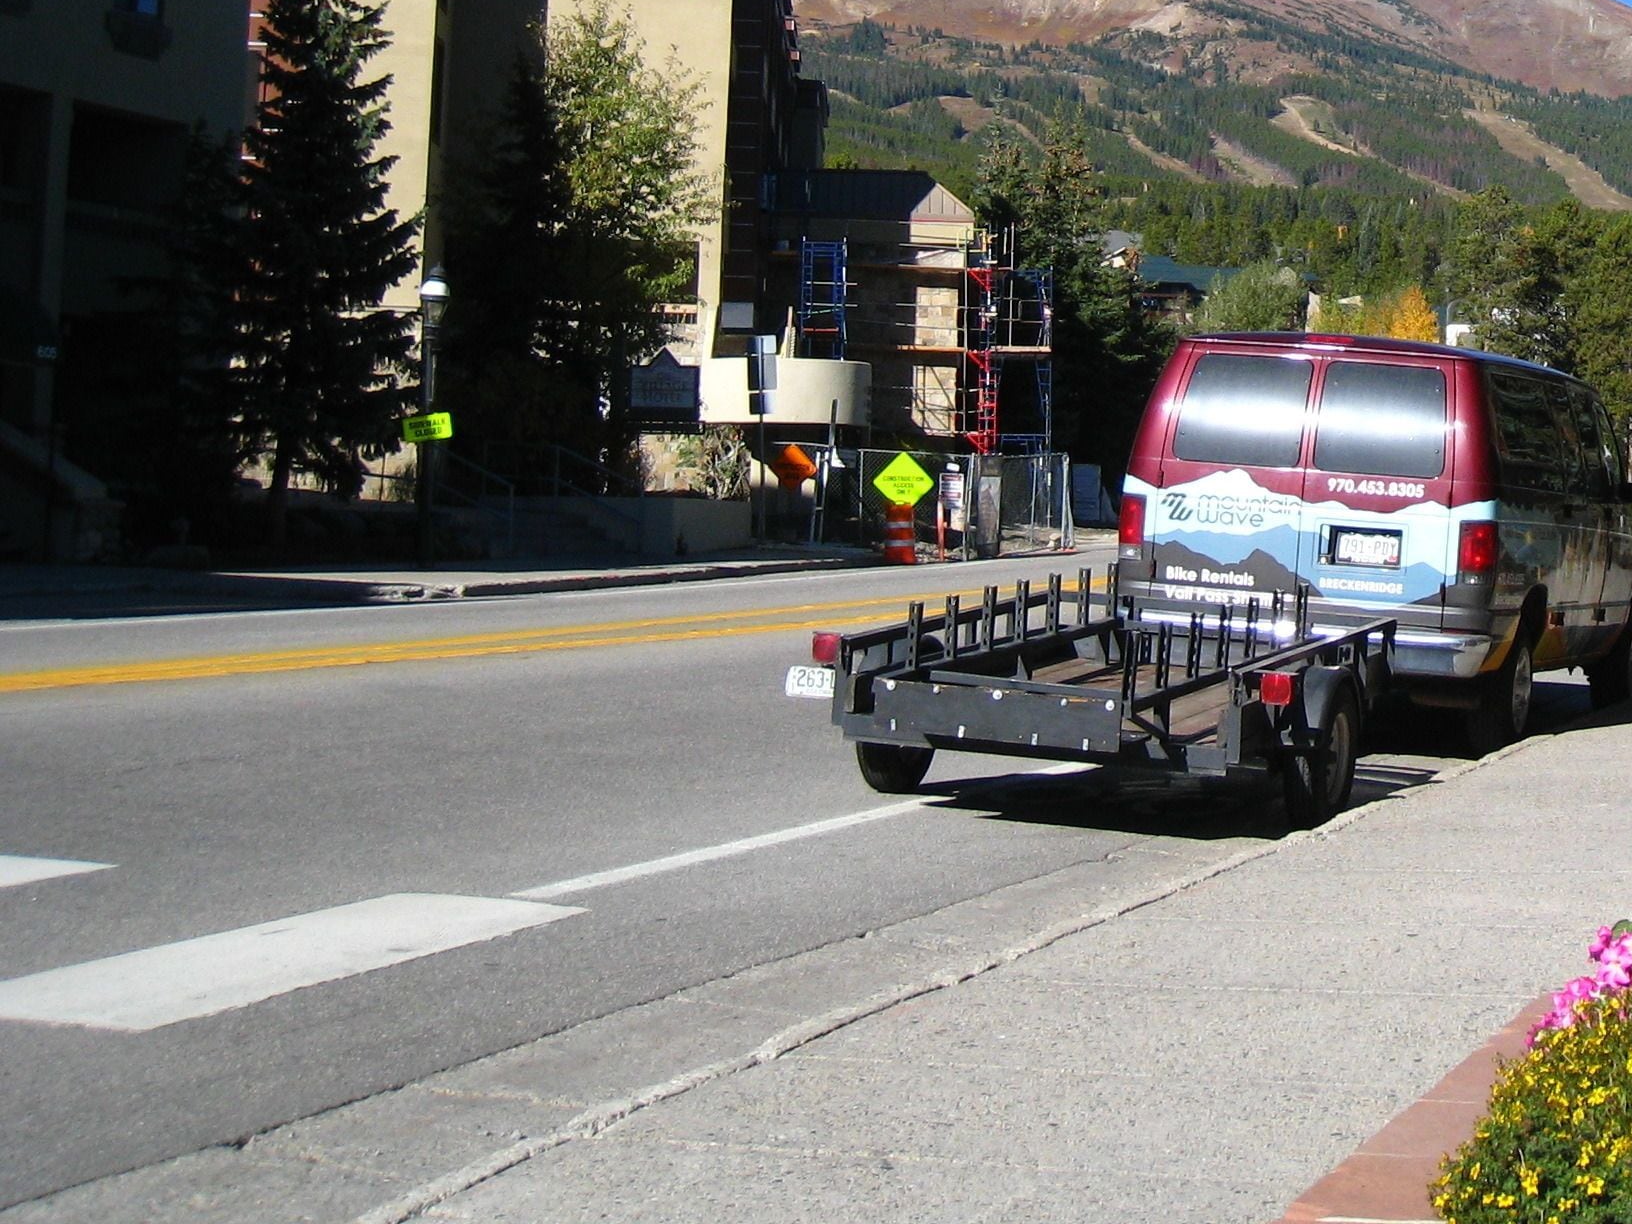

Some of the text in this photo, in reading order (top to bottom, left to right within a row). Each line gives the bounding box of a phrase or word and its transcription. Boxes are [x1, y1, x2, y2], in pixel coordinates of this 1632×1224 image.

[1327, 477, 1425, 498] 970.453.8305
[1198, 494, 1302, 516] mountain
[1196, 509, 1264, 527] wave
[1166, 565, 1255, 587] Bike Rentals
[1320, 576, 1404, 594] BRECKENRIDGE
